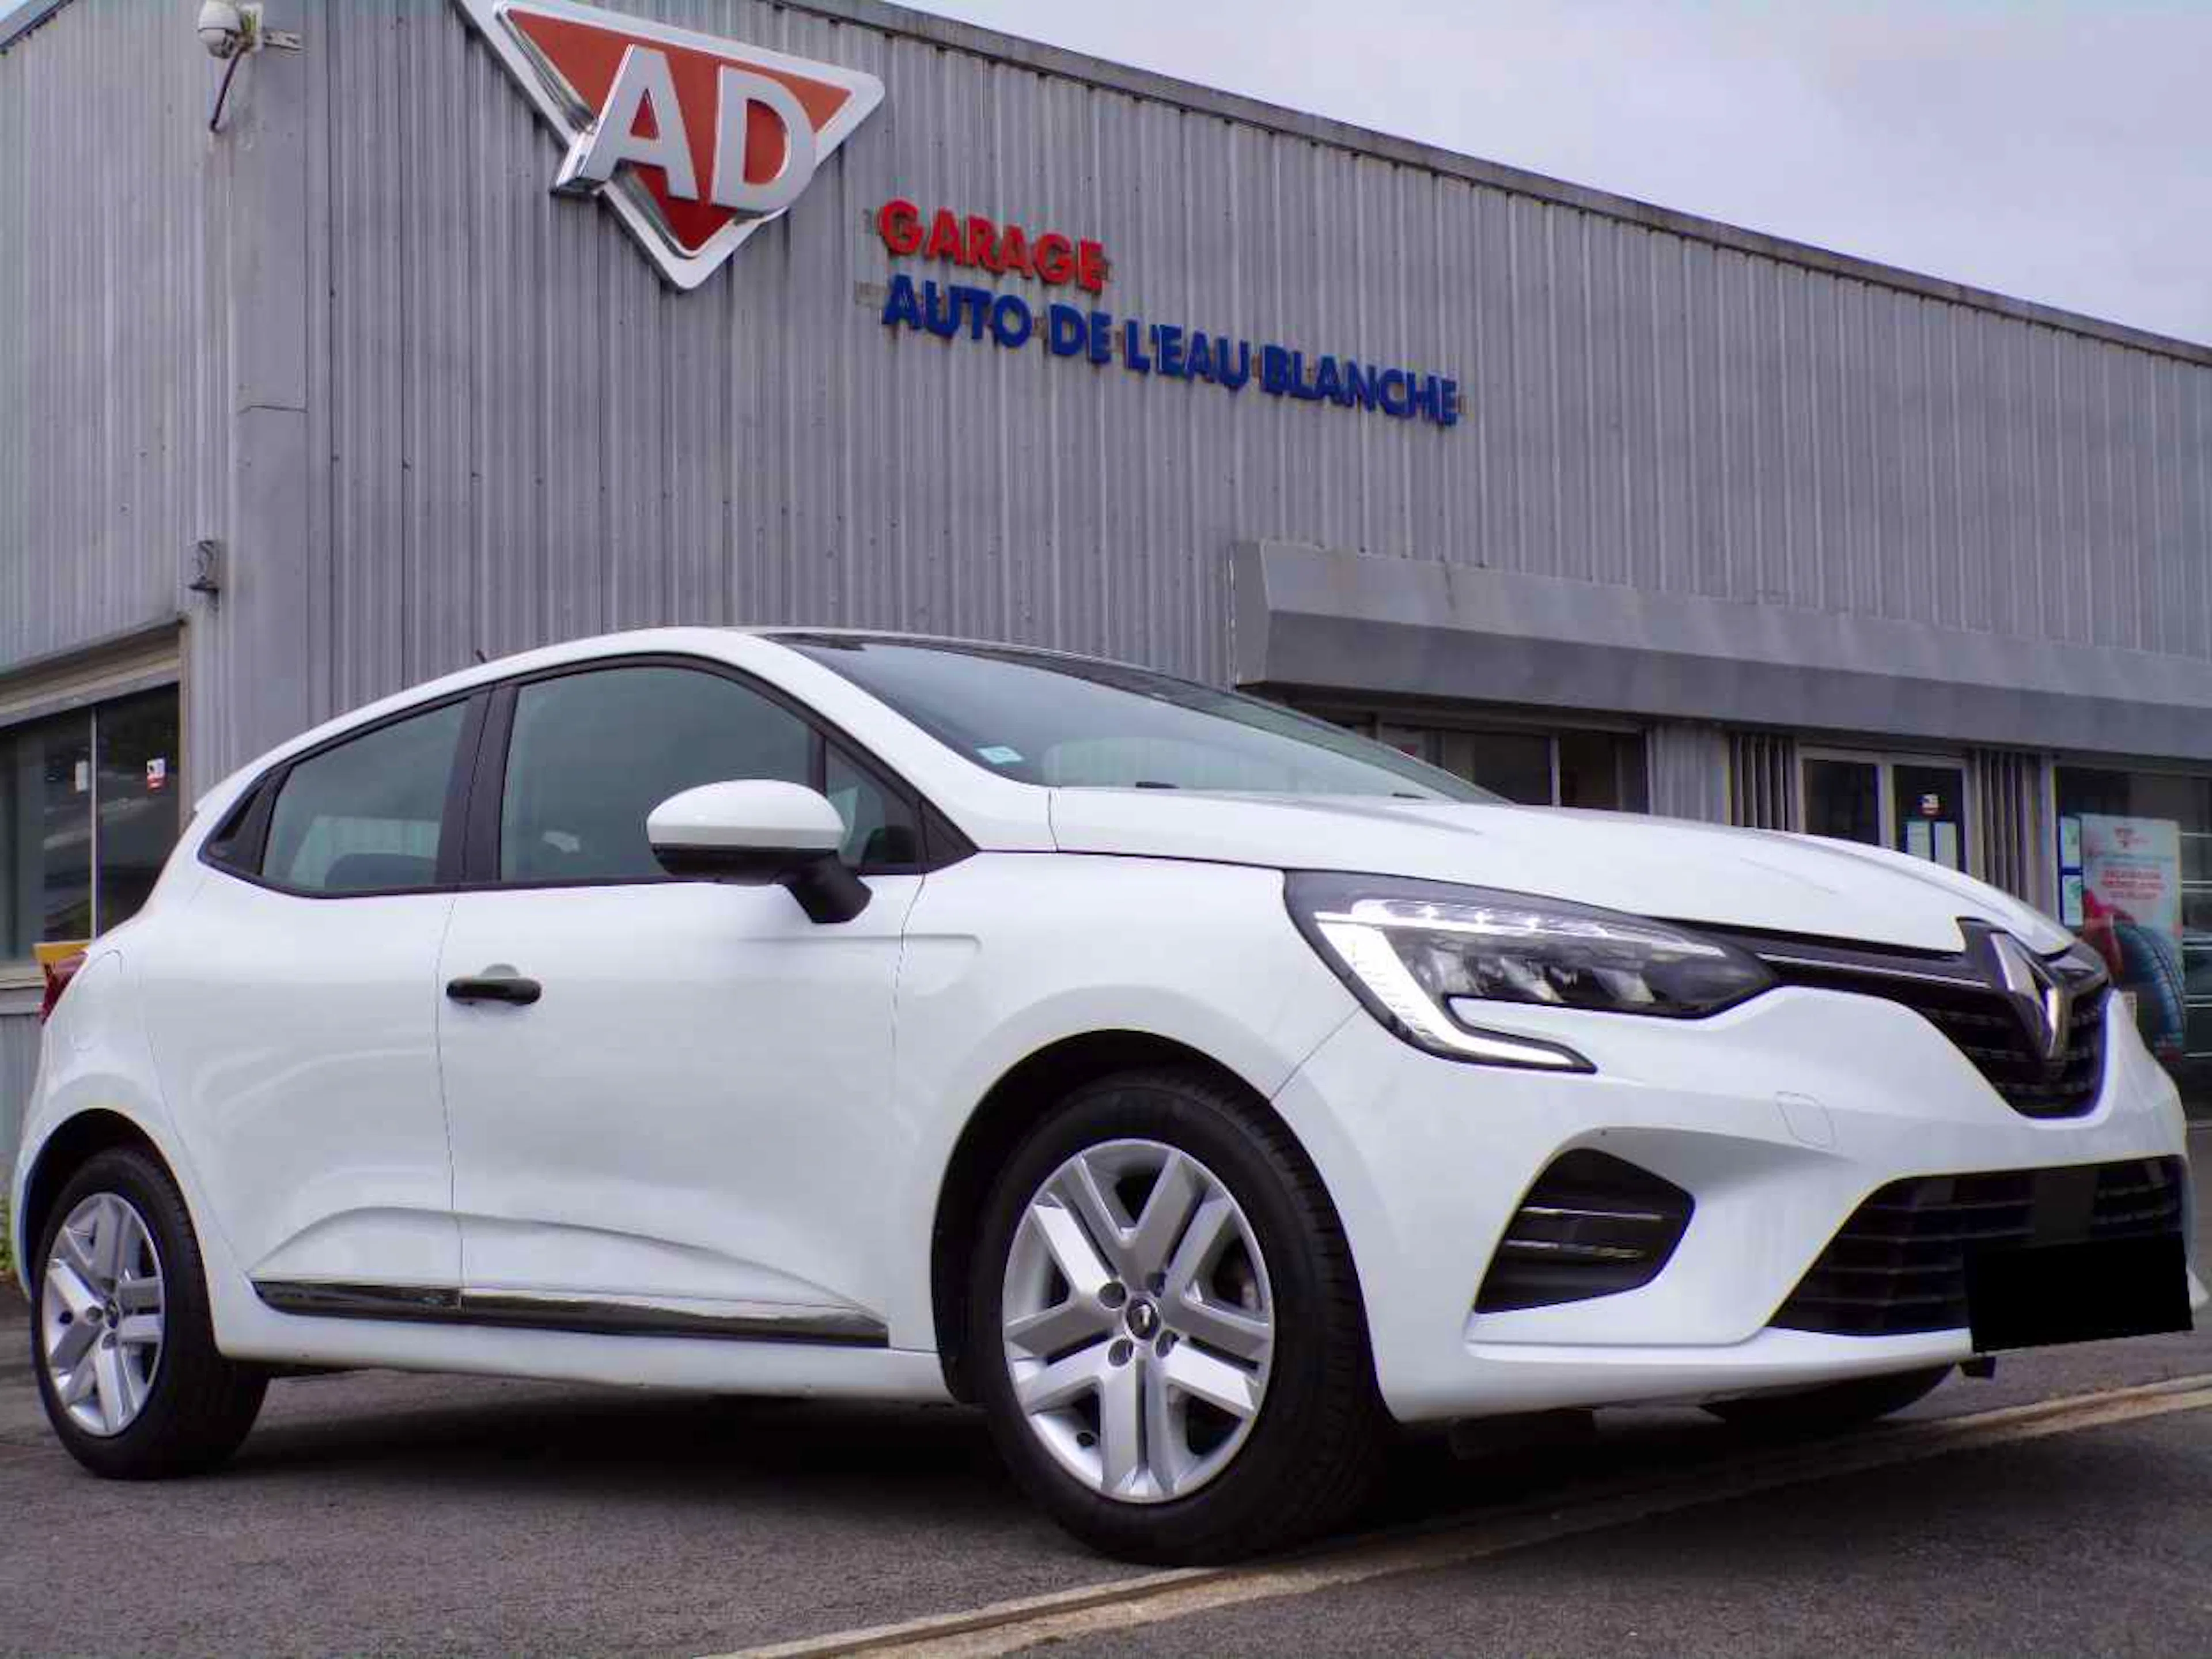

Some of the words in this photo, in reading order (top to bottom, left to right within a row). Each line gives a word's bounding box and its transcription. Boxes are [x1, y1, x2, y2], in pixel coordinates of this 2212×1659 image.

[550, 44, 818, 212] AD
[879, 200, 1105, 293] GARAGE
[882, 274, 1032, 348] AUTO
[1049, 303, 1112, 365] DE
[1126, 320, 1249, 391] L'EAU
[1260, 344, 1457, 426] BLANCHE
